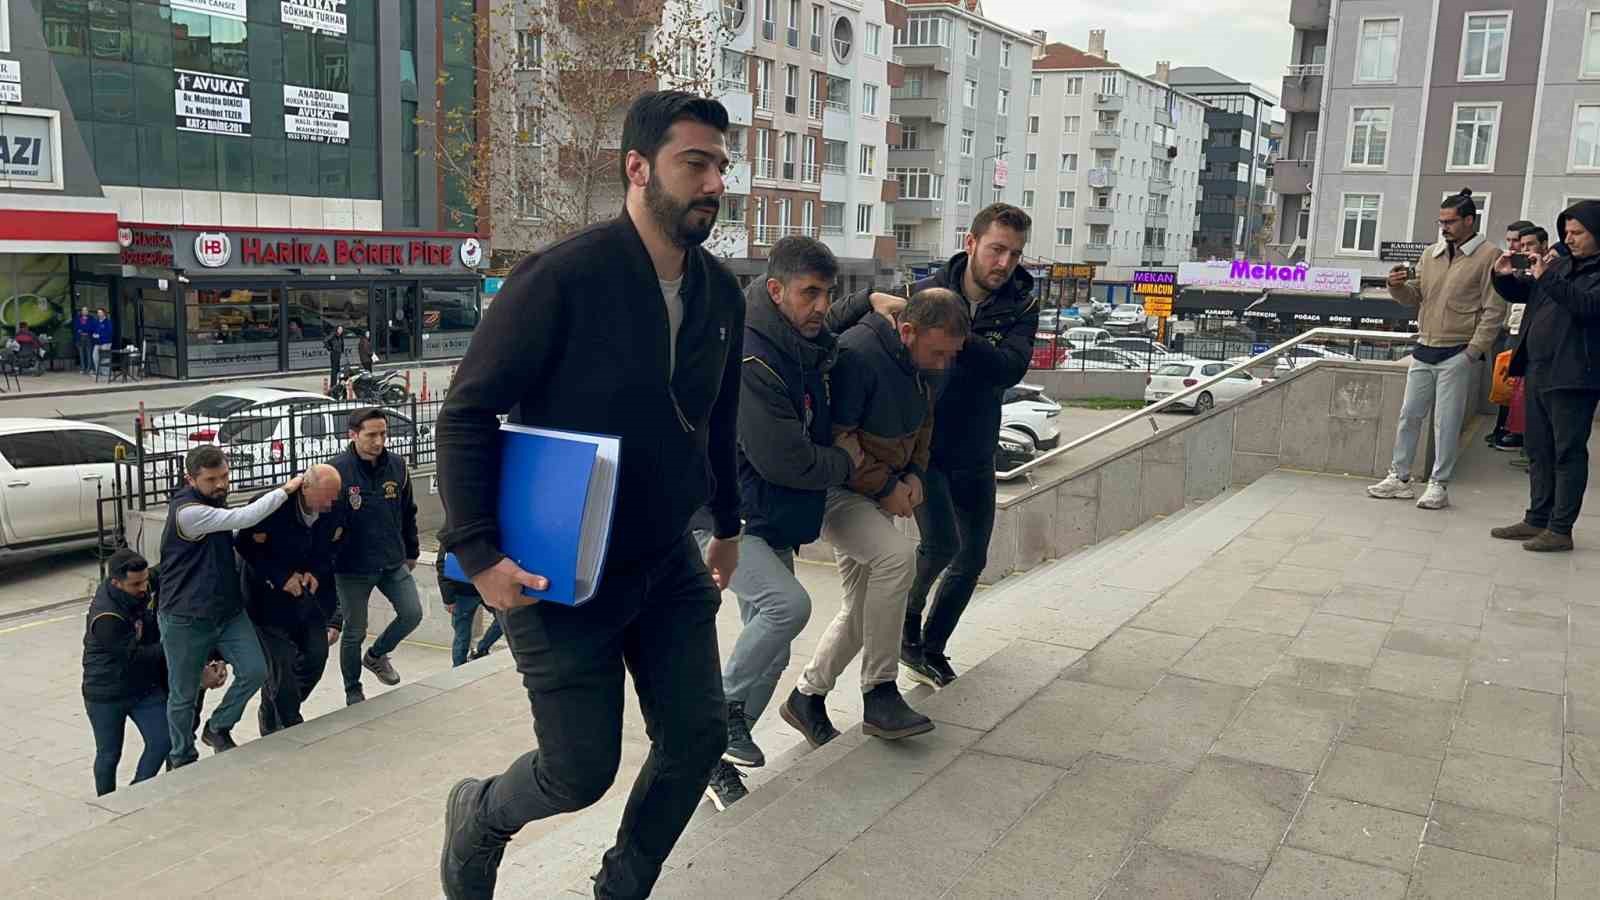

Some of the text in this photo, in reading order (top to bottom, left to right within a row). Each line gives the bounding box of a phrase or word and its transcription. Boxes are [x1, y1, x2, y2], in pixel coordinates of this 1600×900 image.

[316, 11, 345, 26] TURHAN
[192, 75, 244, 95] AVUKAT
[298, 89, 334, 102] ANADOLU
[298, 107, 335, 120] AVUKAT
[205, 240, 222, 255] HB
[242, 237, 329, 266] HARİKA
[334, 239, 404, 266] BÖREK
[1134, 272, 1173, 283] MEKAN
[1230, 260, 1307, 282] Mekan
[1133, 282, 1173, 295] LAHMACUN
